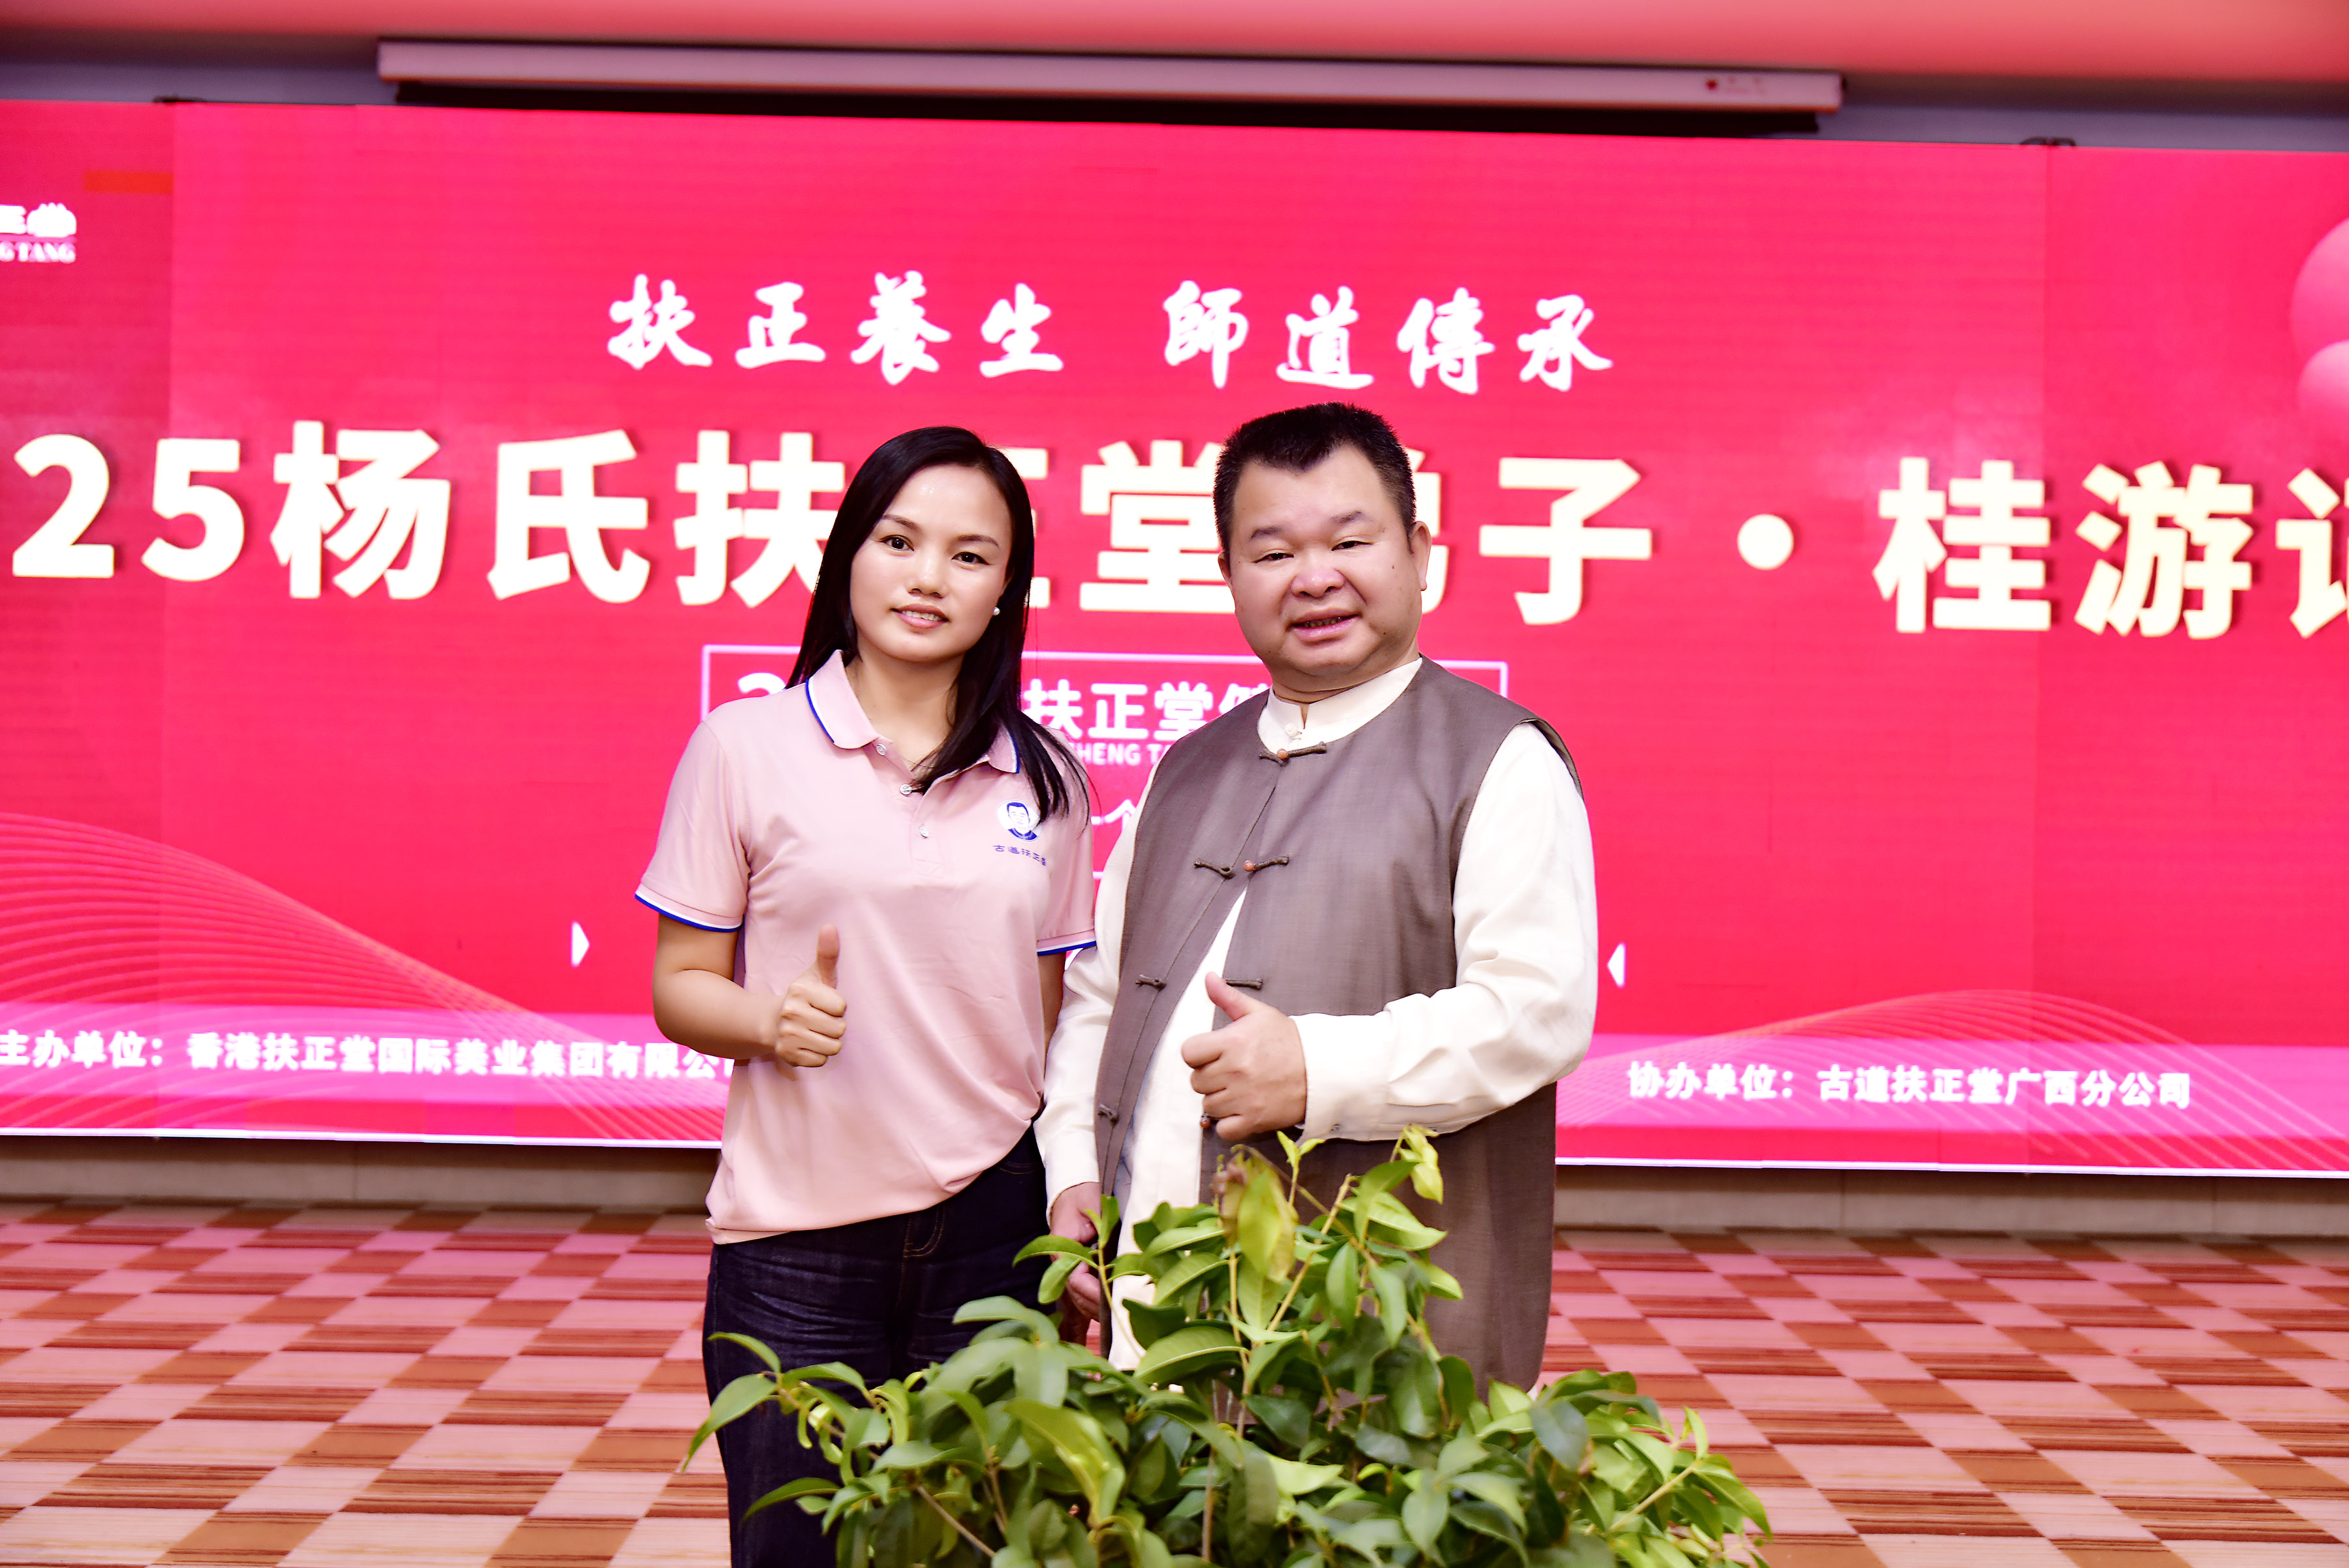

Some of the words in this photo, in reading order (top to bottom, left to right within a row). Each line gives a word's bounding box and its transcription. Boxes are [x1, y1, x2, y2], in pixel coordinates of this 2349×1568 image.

[608, 271, 1063, 385] 扶正養生
[1069, 742, 1141, 765] HENG
[0, 1028, 734, 1080] 主办单位：香港扶正堂国际美业集团有限公
